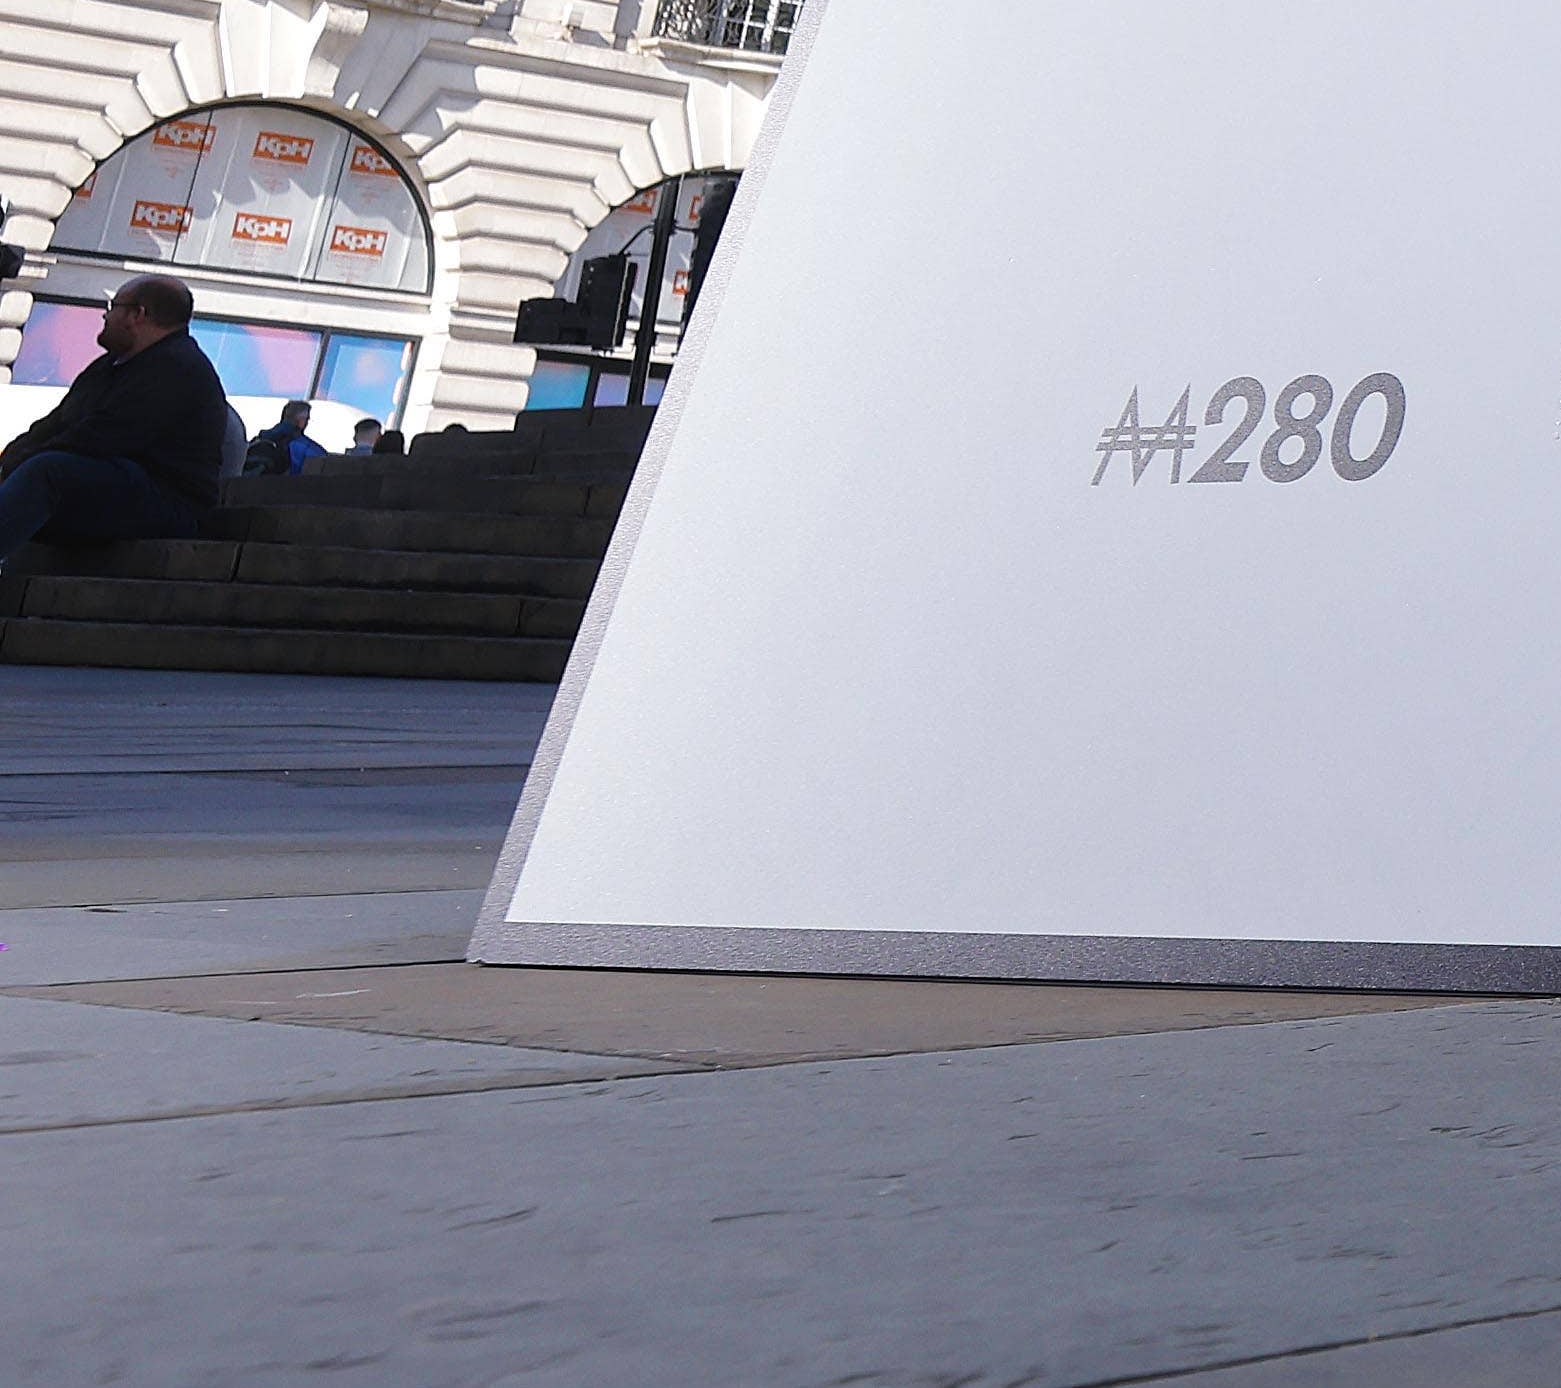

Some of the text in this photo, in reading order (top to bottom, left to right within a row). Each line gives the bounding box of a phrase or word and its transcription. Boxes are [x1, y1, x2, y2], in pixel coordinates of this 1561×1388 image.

[257, 135, 312, 159] KpH
[235, 216, 290, 239] KpH
[334, 228, 385, 252] KpH
